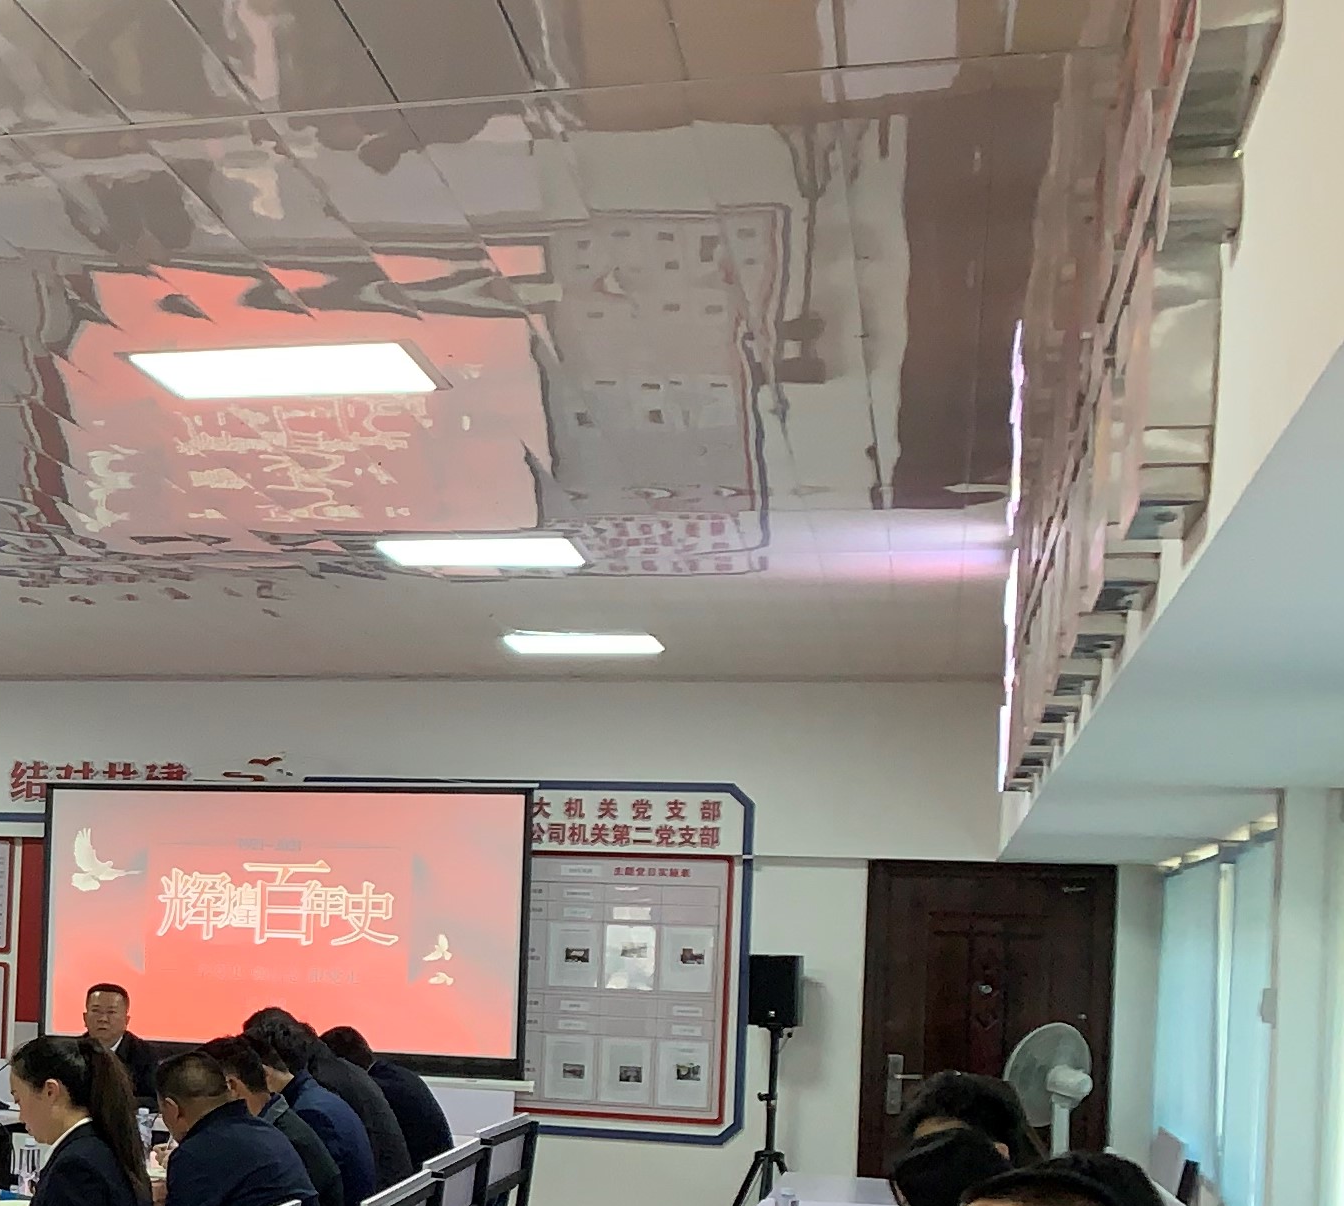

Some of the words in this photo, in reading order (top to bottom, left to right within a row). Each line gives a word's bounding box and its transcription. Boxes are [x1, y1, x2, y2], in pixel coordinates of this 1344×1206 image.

[156, 860, 399, 946] 辉煌百年史
